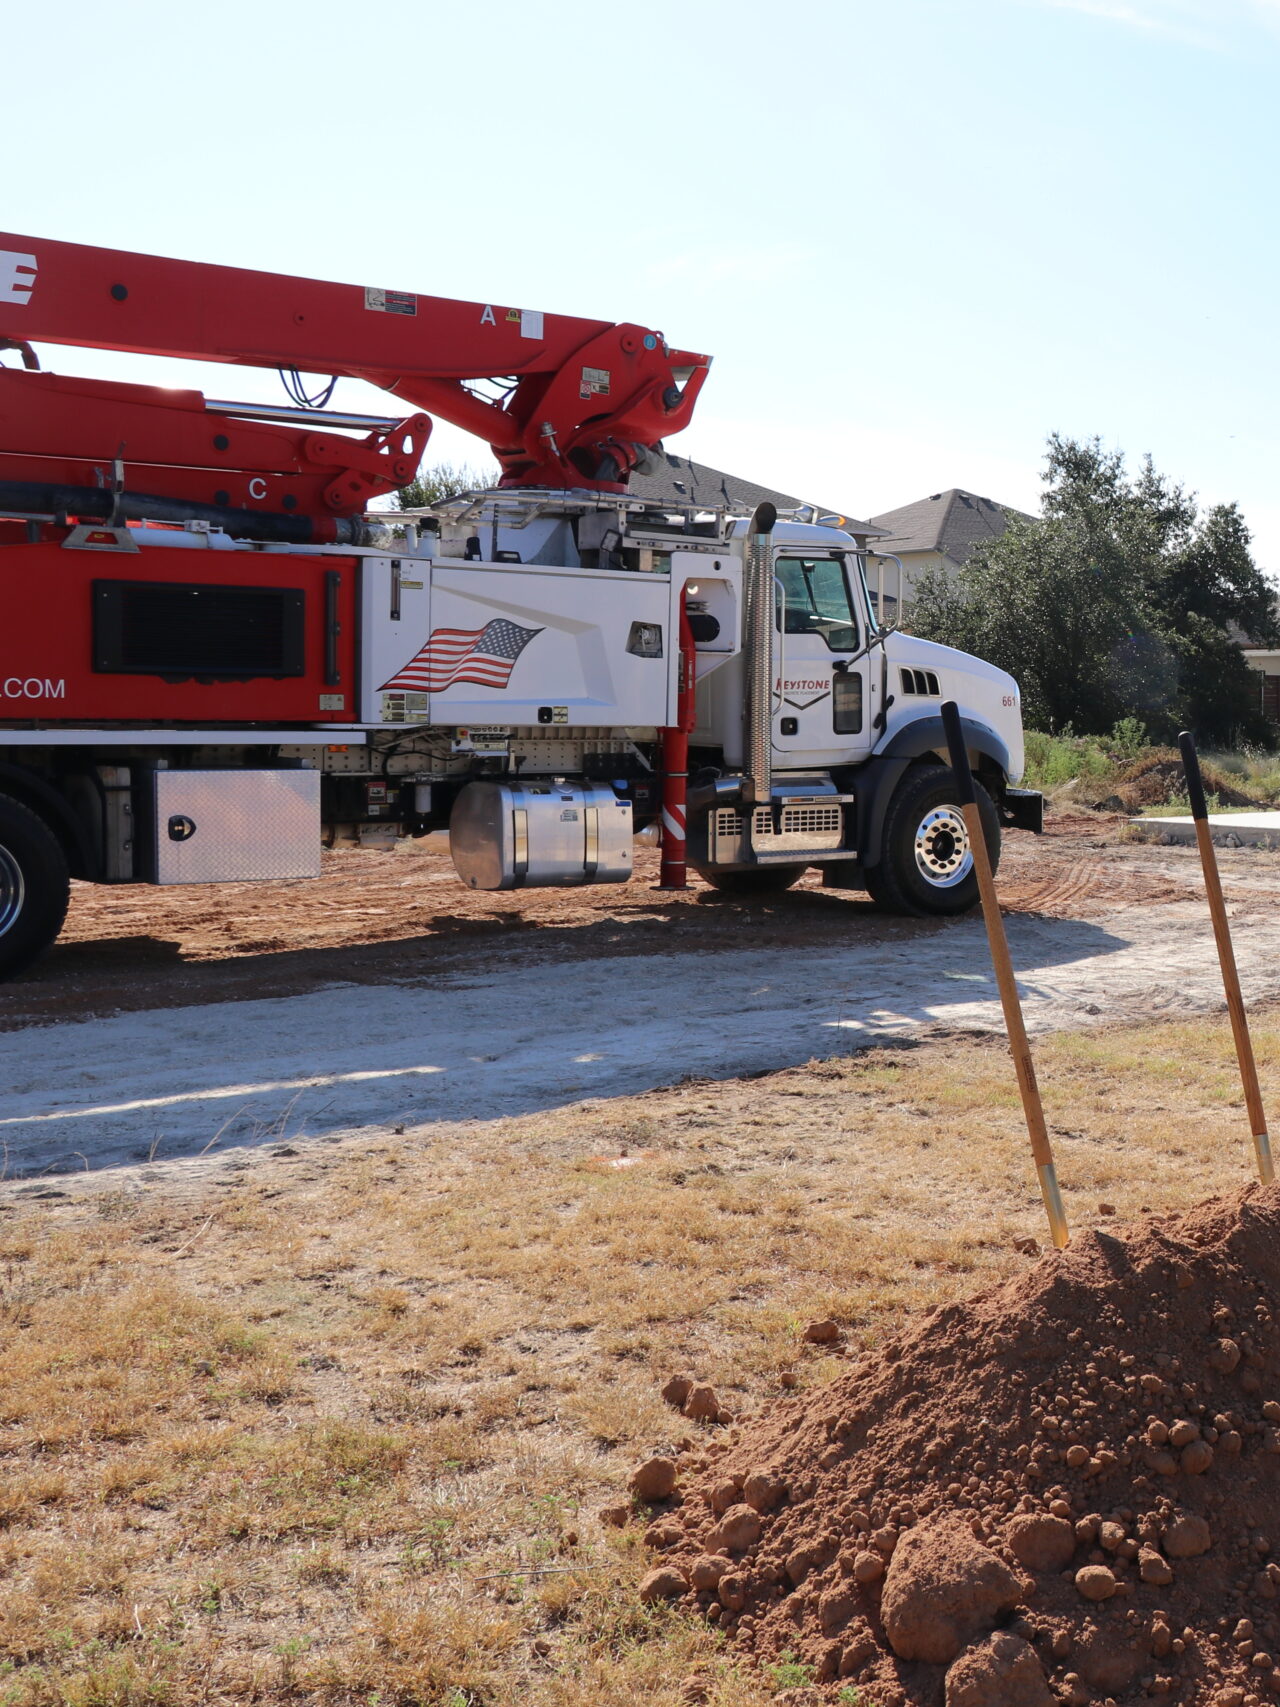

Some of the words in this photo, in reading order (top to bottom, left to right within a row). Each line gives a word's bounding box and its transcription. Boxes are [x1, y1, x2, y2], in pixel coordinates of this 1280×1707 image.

[480, 304, 496, 326] A
[249, 477, 267, 500] C
[1002, 696, 1016, 707] 661
